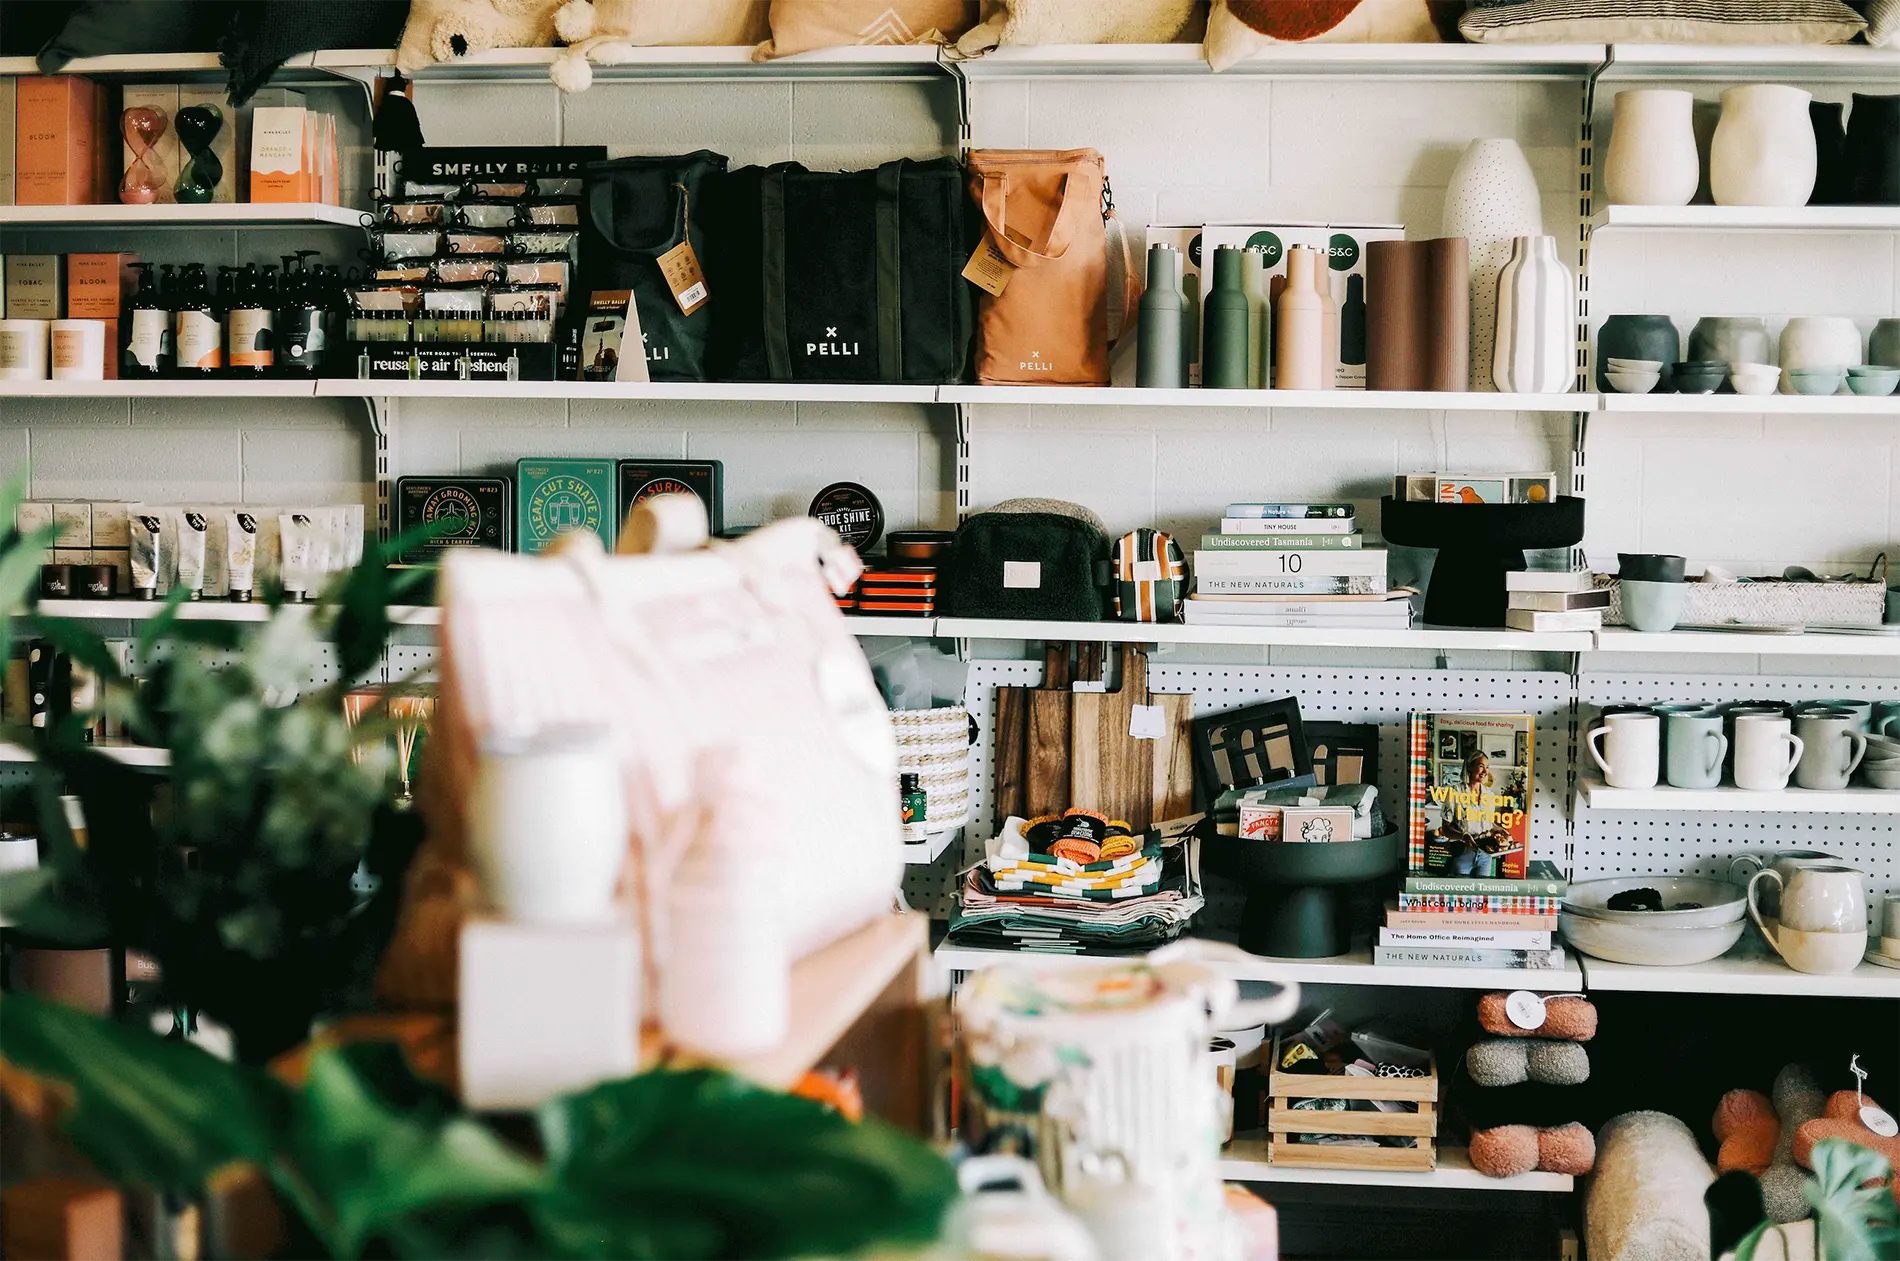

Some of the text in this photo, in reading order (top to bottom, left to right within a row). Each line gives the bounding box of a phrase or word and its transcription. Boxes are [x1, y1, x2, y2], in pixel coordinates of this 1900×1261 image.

[432, 163, 508, 176] SMELLY
[1329, 246, 1353, 257] S&C
[806, 342, 859, 356] PELLI
[373, 358, 429, 371] reusae
[432, 358, 450, 371] air
[1019, 361, 1053, 371] PELLI
[440, 489, 478, 518] GROOMING
[532, 497, 548, 536] CLEAN
[541, 479, 563, 496] CUT
[567, 480, 598, 513] SHAVE
[818, 510, 871, 526] SHOE SHINE
[839, 524, 852, 533] KIT
[1211, 537, 1270, 547] Undiscovered
[1272, 537, 1313, 547] Tasmania
[1278, 553, 1302, 573] 10
[1429, 785, 1514, 807] What can
[1466, 805, 1523, 829] bring?
[1251, 819, 1274, 829] FANCY
[1415, 881, 1519, 892] Undiscovered Tasmania
[1405, 898, 1432, 907] What
[1433, 900, 1452, 908] can
[1459, 899, 1489, 910] bring?
[1452, 934, 1495, 942] Reimagined
[1408, 953, 1428, 961] NEW
[1432, 954, 1483, 962] NATURALS
